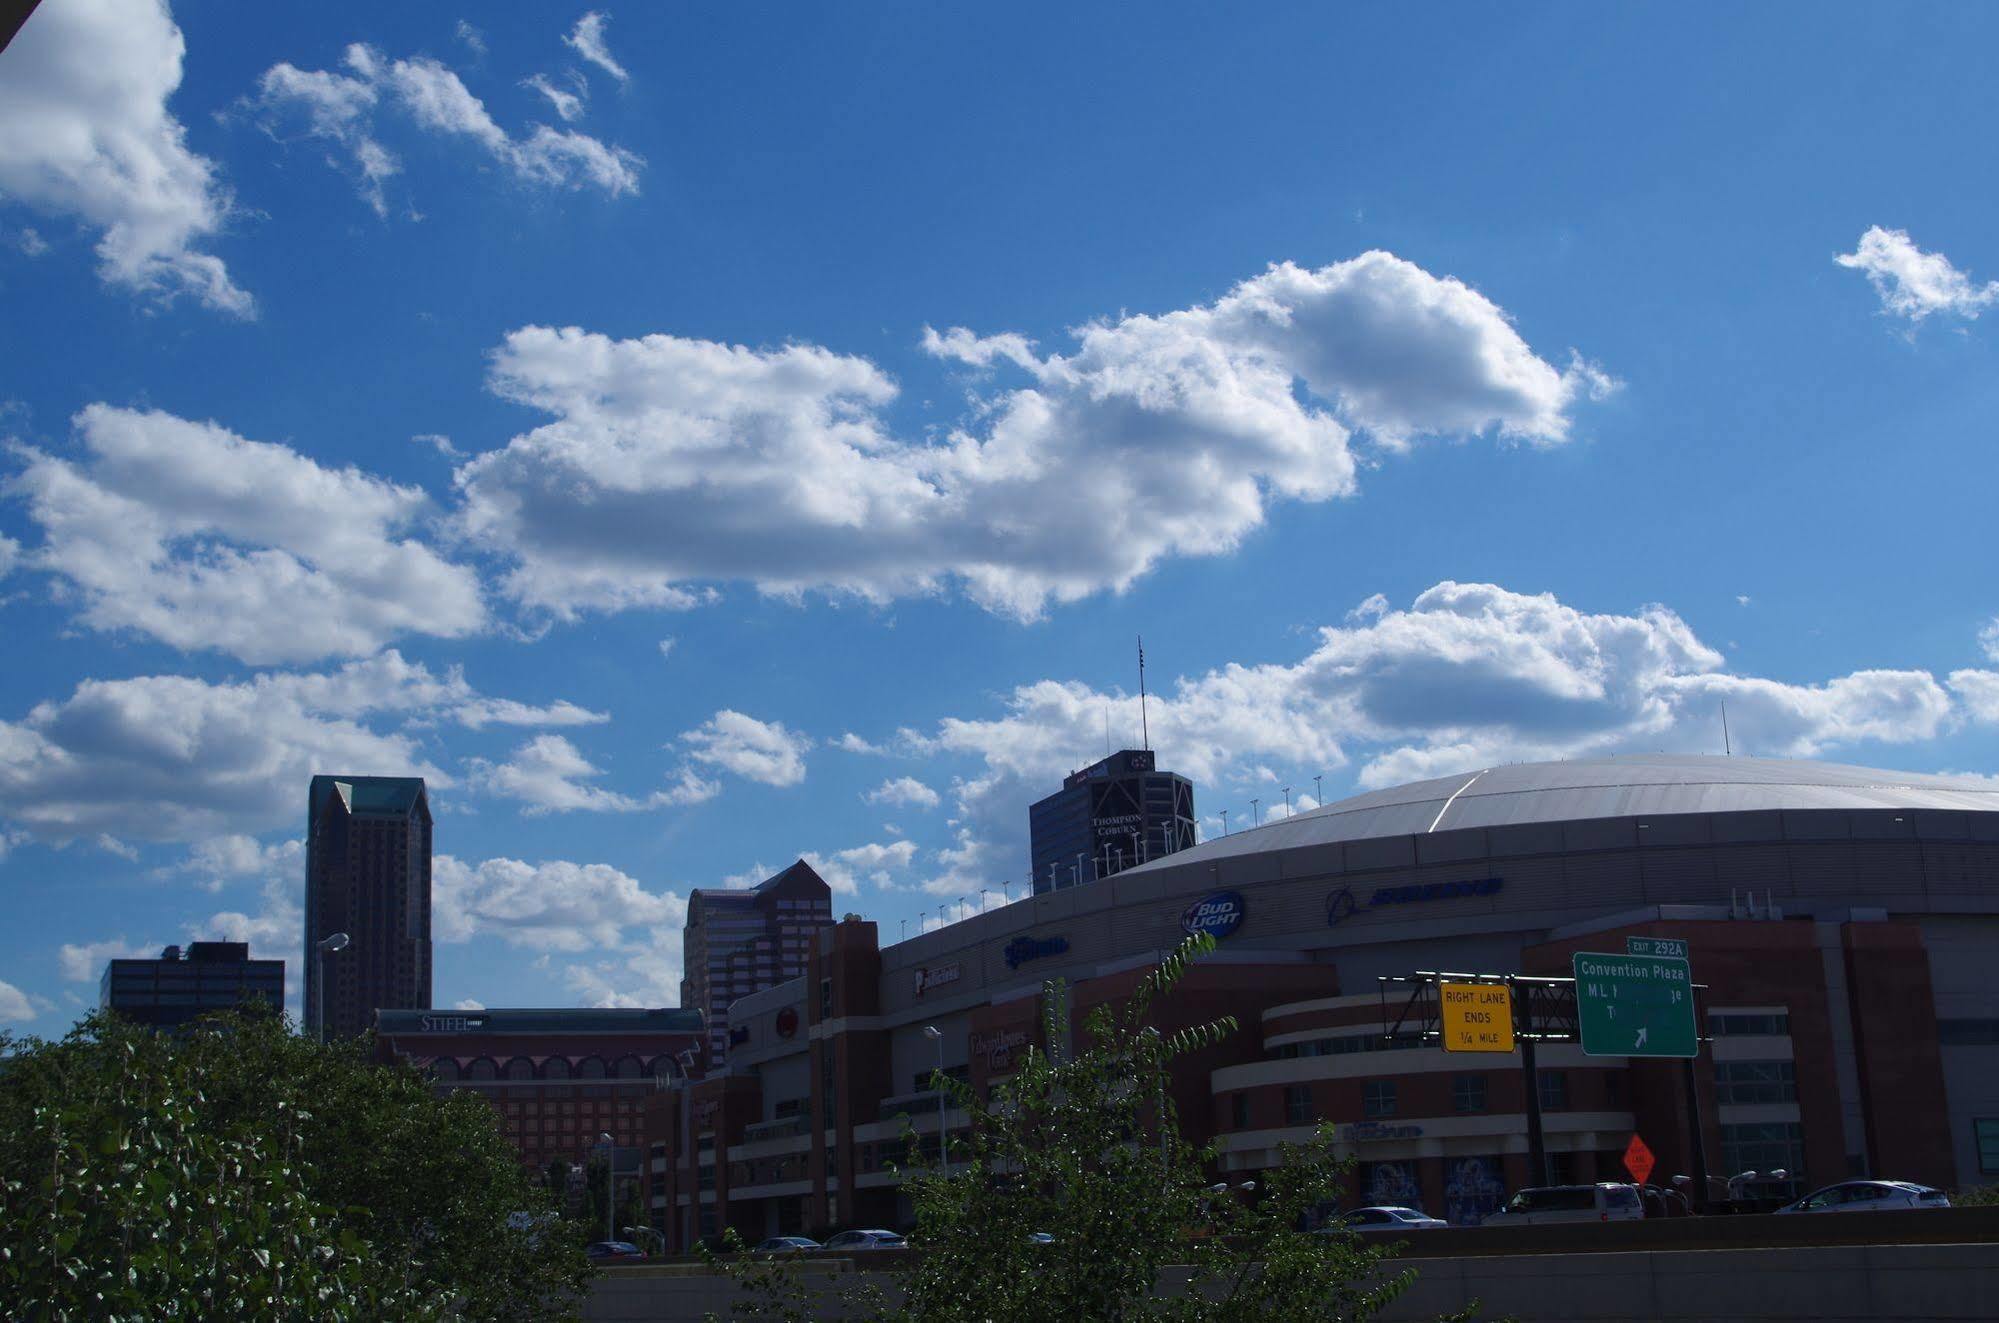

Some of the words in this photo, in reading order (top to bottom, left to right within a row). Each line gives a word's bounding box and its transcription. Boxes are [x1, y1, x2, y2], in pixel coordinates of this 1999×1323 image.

[1197, 902, 1234, 916] BUD
[1190, 912, 1241, 928] LIGHT
[1633, 942, 1649, 952] EXIT
[1655, 942, 1683, 956] 292A
[1581, 961, 1649, 979] Convention
[1652, 964, 1684, 980] Plaza
[1446, 991, 1474, 1003] RIGHT
[1480, 992, 1505, 1004] LANE
[1464, 1011, 1491, 1024] ENDS
[1479, 1032, 1499, 1043] MILE
